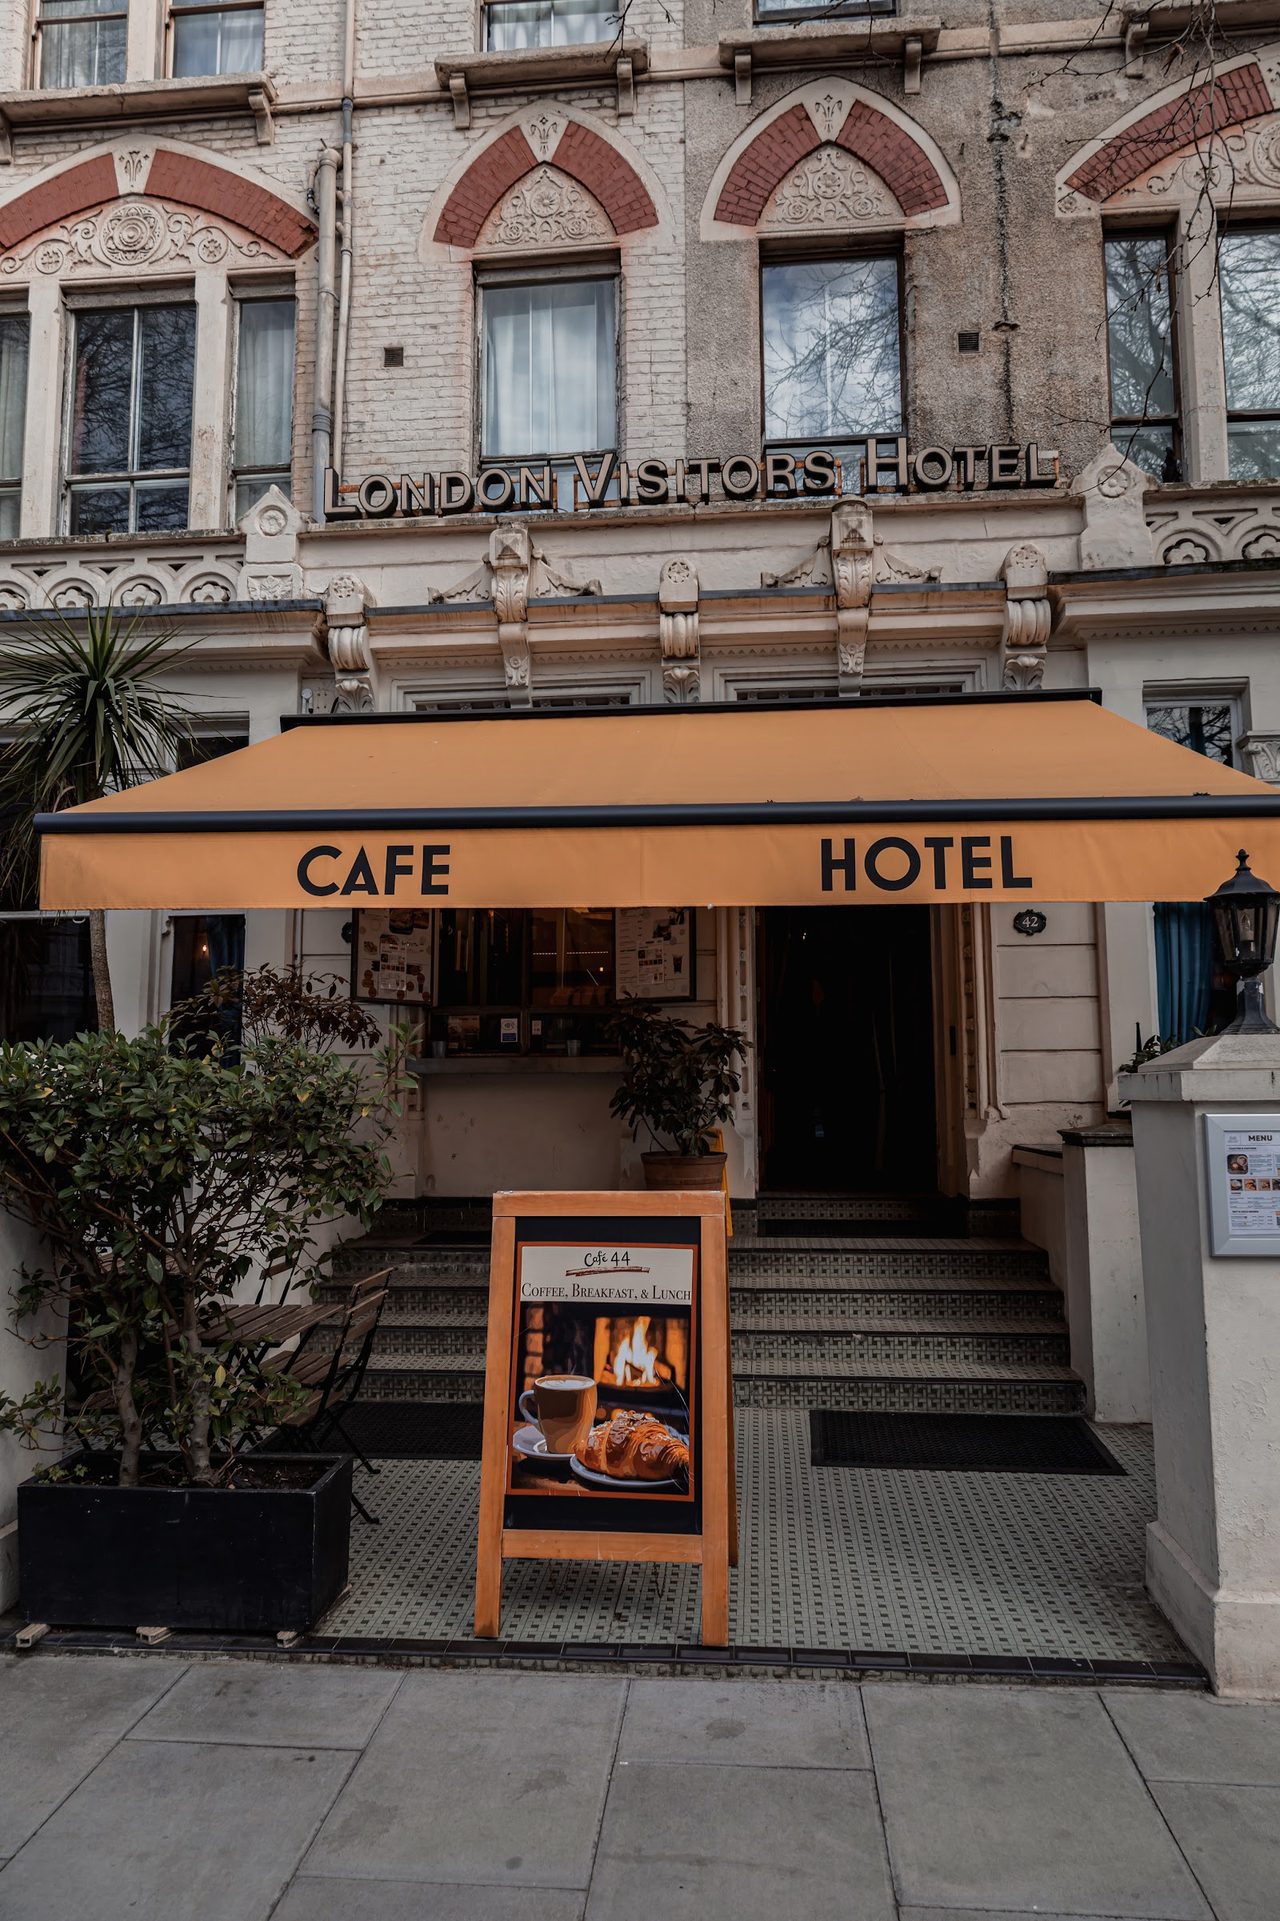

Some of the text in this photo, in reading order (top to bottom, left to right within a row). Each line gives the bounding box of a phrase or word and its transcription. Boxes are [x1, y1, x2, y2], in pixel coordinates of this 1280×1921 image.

[324, 437, 1057, 519] LONDON VISITORS HOTEL
[297, 836, 1032, 896] CAFE HOTEL
[1022, 916, 1039, 928] 42
[610, 1251, 630, 1266] 44
[640, 1289, 649, 1298] &
[652, 1285, 691, 1301] LUNCH
